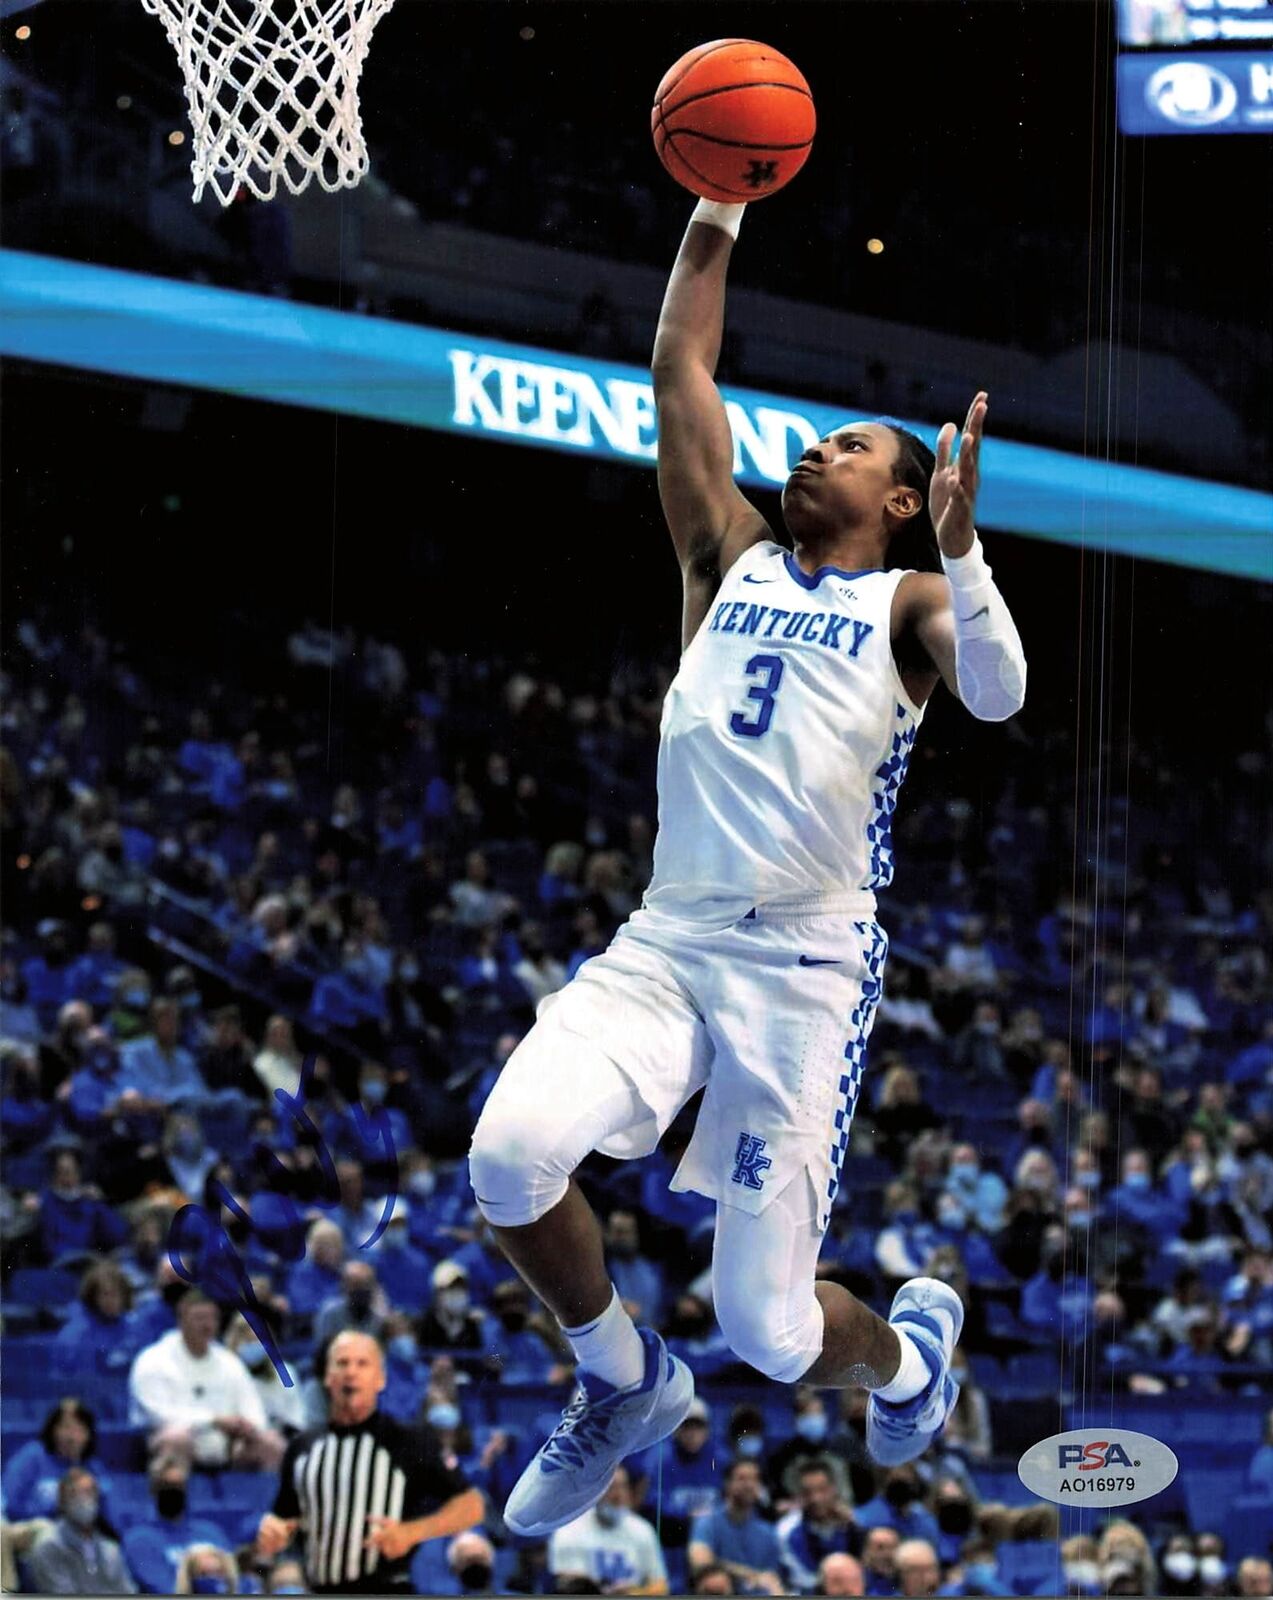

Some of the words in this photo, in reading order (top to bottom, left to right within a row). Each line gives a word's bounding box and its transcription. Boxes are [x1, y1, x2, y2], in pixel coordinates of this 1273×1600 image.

[448, 348, 826, 484] KEENEND
[708, 602, 874, 657] KENTUCKY
[730, 654, 785, 738] 3
